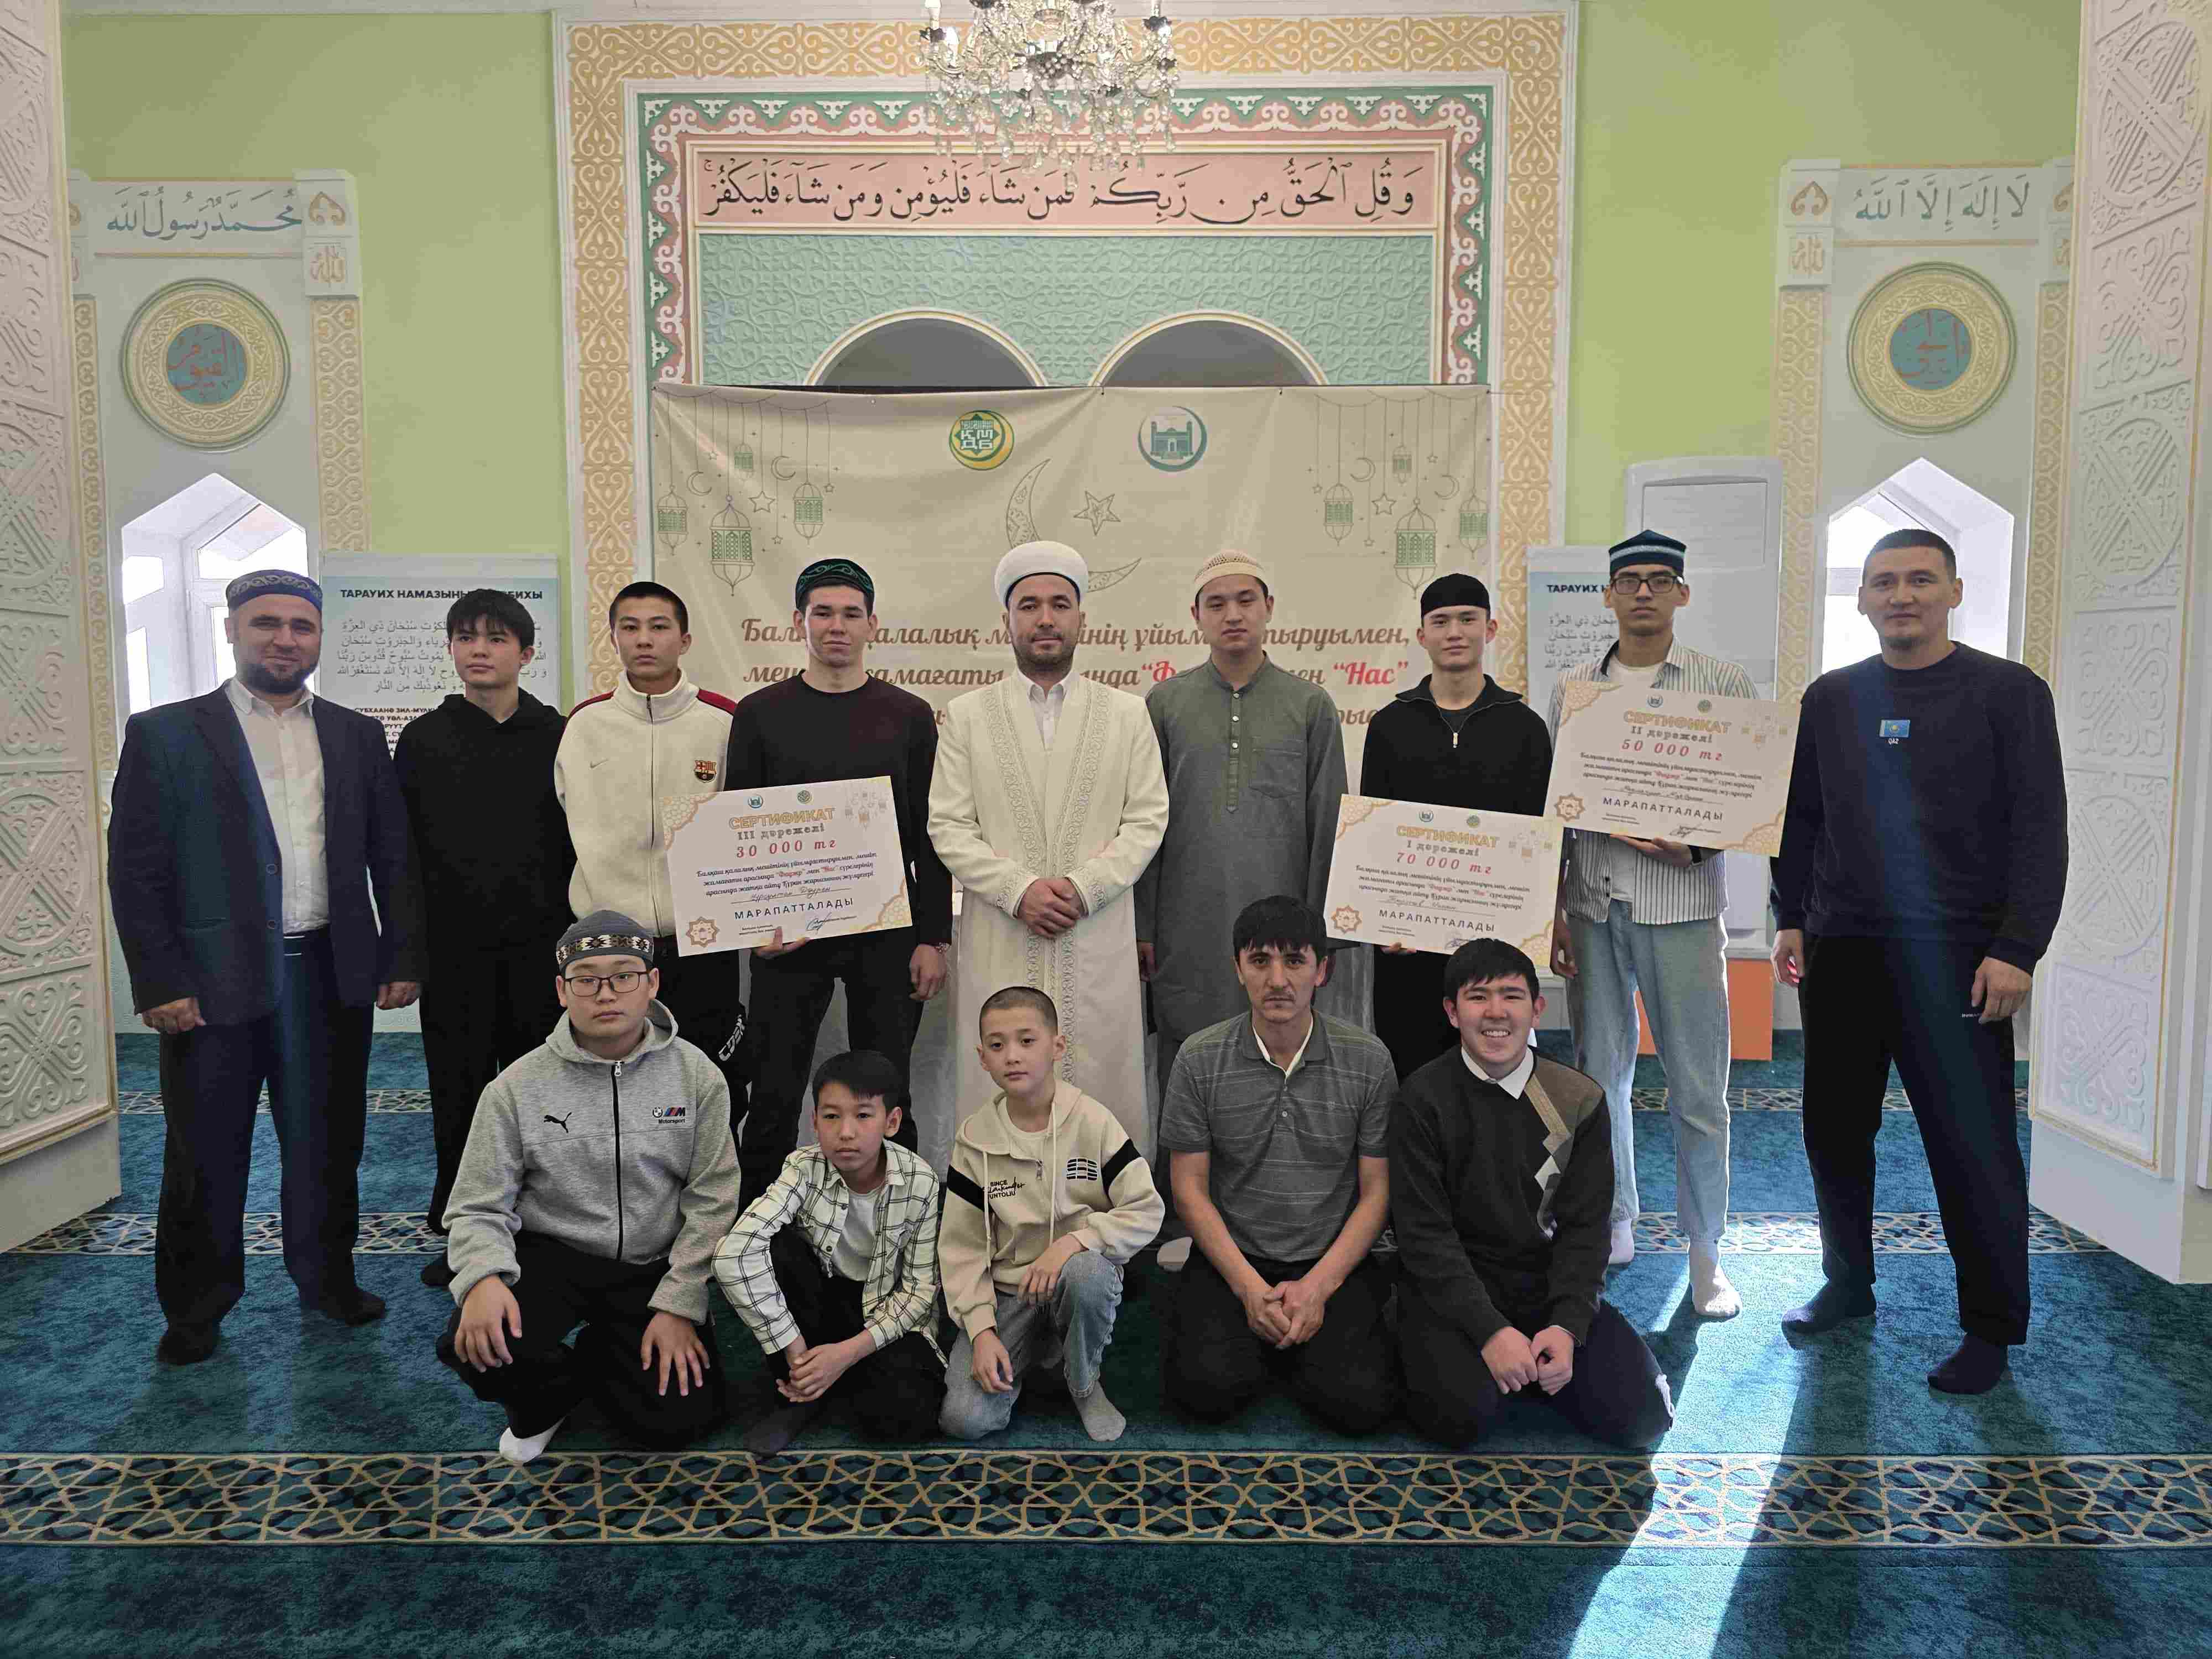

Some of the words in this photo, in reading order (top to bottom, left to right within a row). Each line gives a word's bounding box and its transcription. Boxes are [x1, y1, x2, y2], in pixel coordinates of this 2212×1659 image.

[341, 589, 394, 598] ТАРАУИХ
[398, 590, 470, 599] НАМАЗЫНЫ
[1547, 585, 1598, 593] ТАРАУИХ
[742, 619, 805, 642] Бал
[1623, 711, 1732, 734] СЕРТИФИКАТ
[1622, 739, 1643, 752] 50
[1654, 743, 1689, 757] 000
[729, 808, 836, 830] СЕРТИФИКАТ
[1603, 796, 1722, 820] МАРАПАТТАЛАДЫ
[1397, 826, 1500, 848] СЕРТИФИКАТ
[737, 845, 757, 858] 30
[769, 840, 803, 854] 000
[1396, 852, 1416, 864] 70
[1426, 855, 1460, 870] 000
[734, 898, 854, 920] МАРАПАТТАЛАДЫ
[1379, 909, 1495, 932] МАРАПАТТАЛАДЫ
